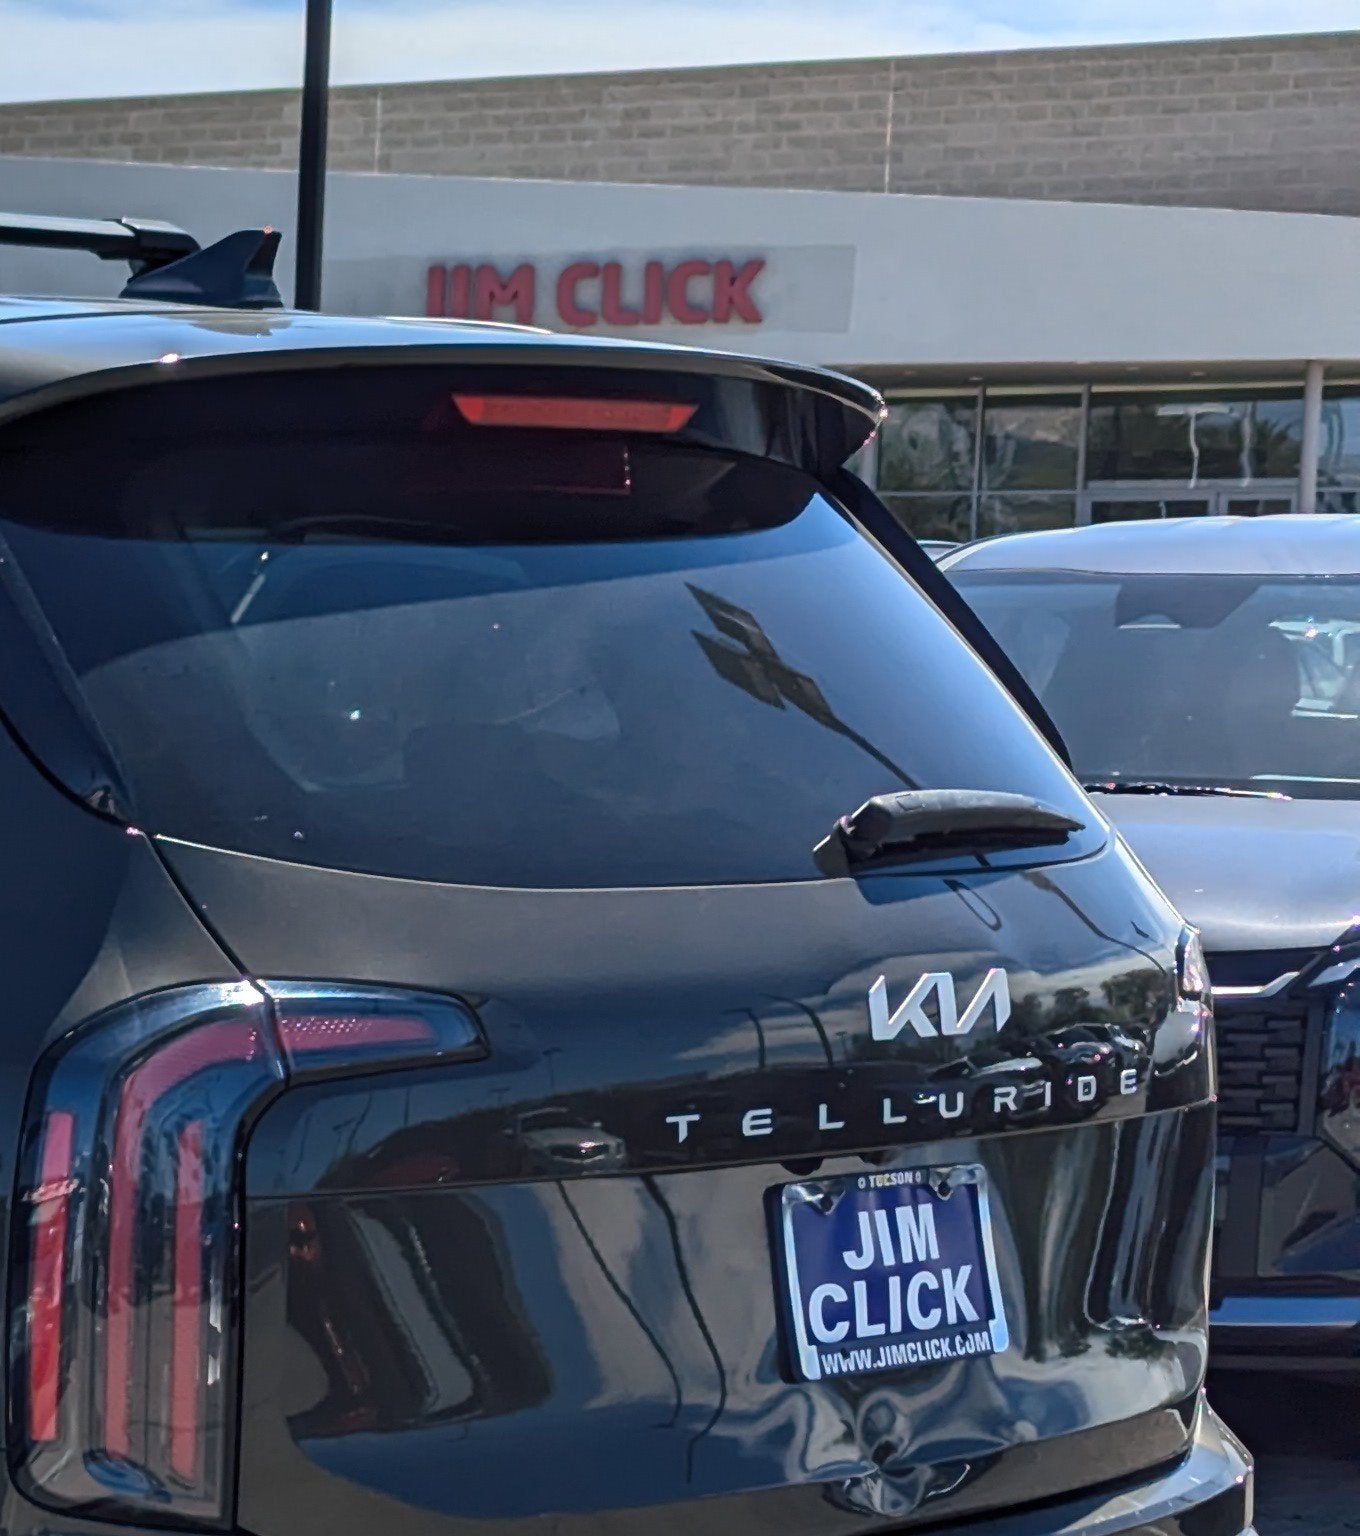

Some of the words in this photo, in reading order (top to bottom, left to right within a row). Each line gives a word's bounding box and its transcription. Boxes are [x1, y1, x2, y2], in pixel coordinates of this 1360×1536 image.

[425, 262, 536, 324] JIM
[555, 258, 767, 327] CLICK
[867, 967, 1012, 1042] KIA
[665, 1068, 1140, 1144] TELLURIDE
[869, 1171, 914, 1189] TUCSON
[842, 1202, 941, 1271] JIM
[808, 1264, 981, 1344] CLICK
[820, 1330, 992, 1375] WWW.JIMCLICK.COM
